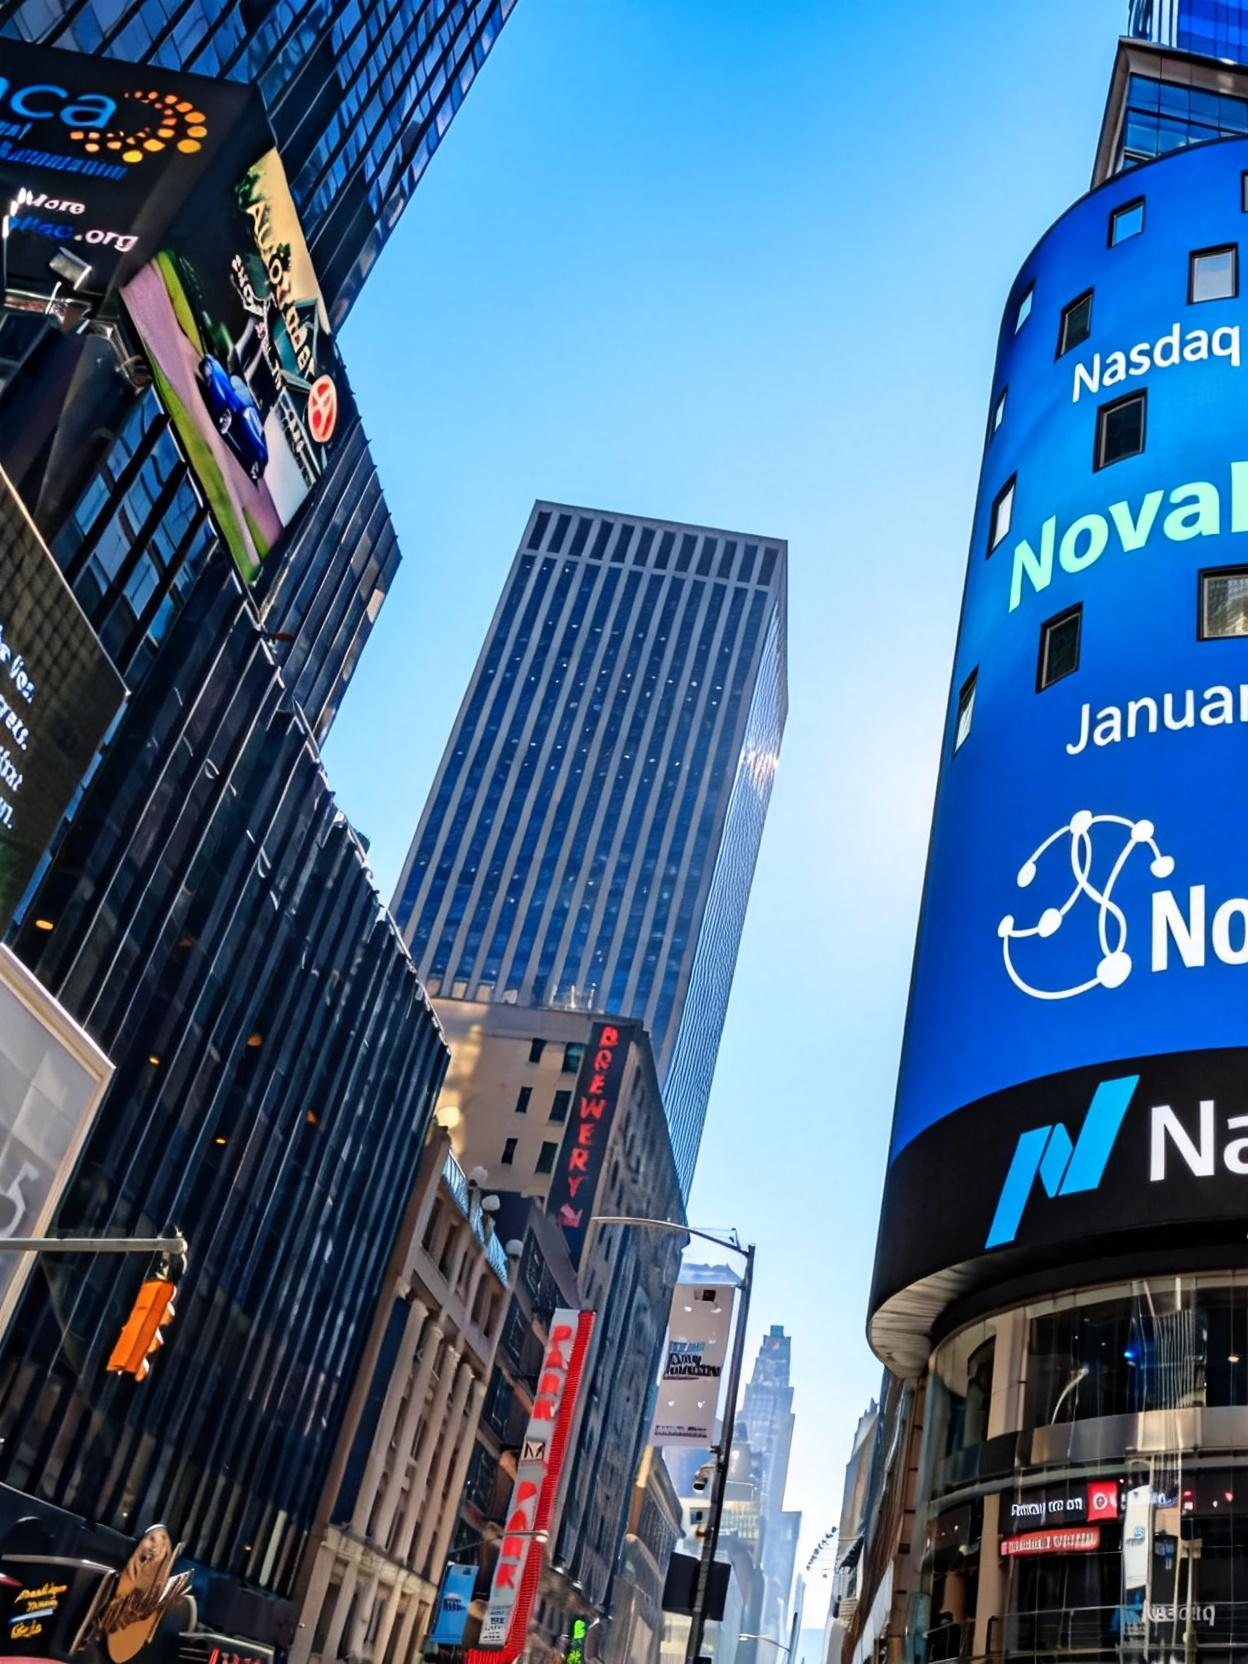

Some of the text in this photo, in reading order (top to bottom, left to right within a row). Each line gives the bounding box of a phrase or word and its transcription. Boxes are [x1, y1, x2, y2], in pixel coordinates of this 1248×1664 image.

[0, 76, 117, 129] ca
[1072, 322, 1241, 403] Nasdaq
[567, 1025, 620, 1199] BREWERY
